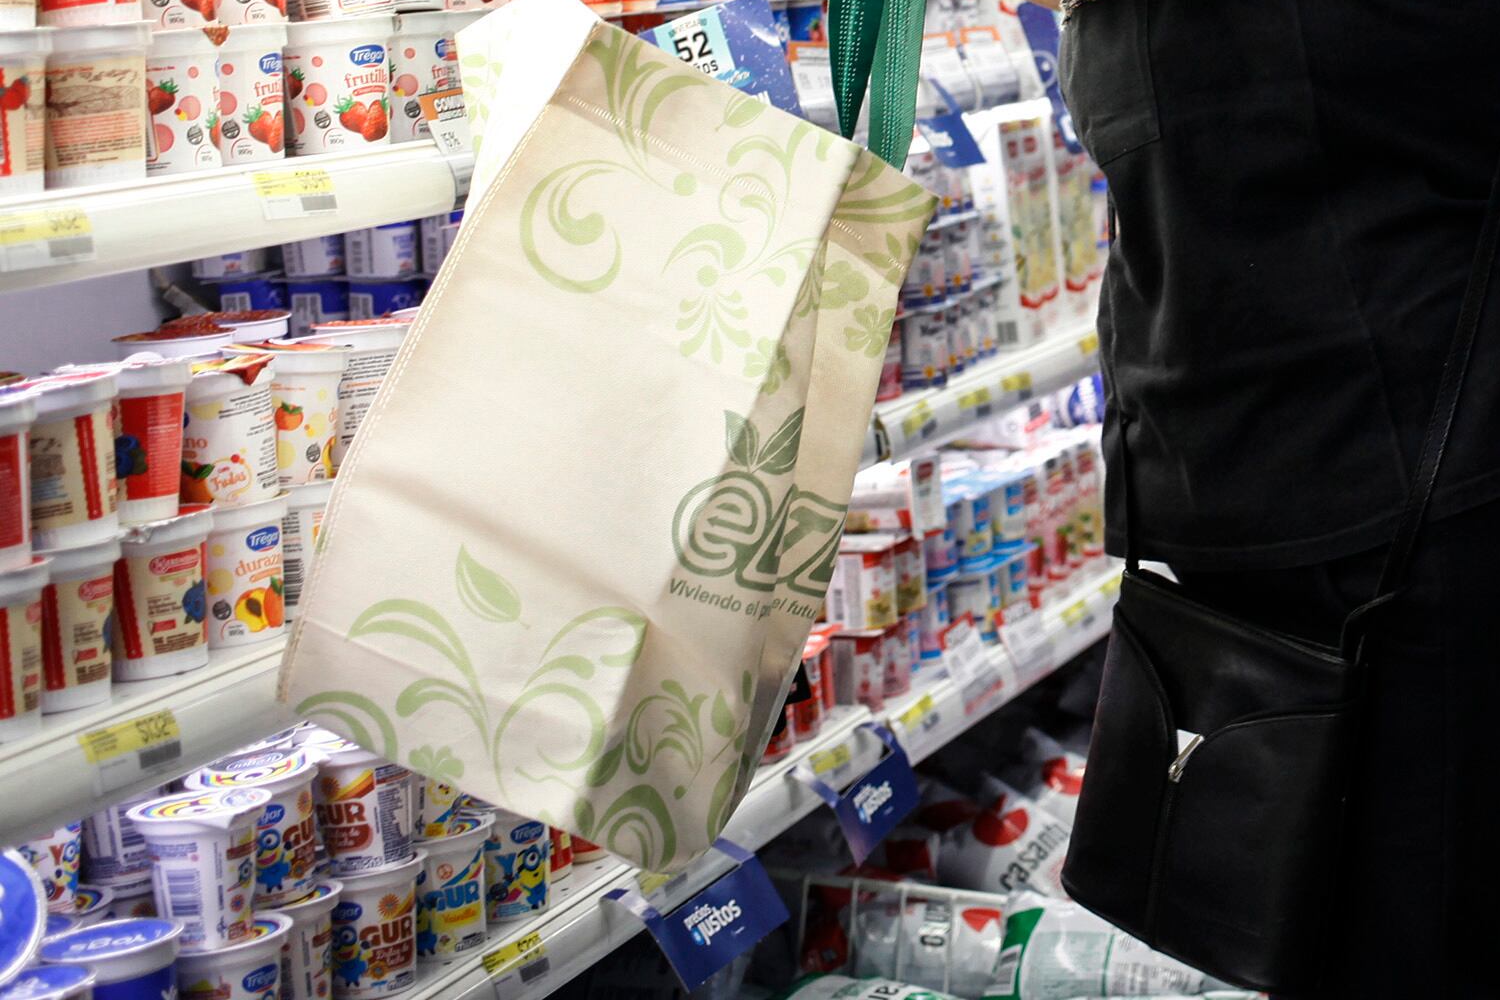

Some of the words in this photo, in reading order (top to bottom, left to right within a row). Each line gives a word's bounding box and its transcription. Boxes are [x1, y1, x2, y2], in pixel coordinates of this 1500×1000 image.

[674, 31, 713, 64] 52
[669, 578, 742, 614] Viviendo
[744, 602, 760, 616] el
[359, 917, 413, 945] GUR
[683, 903, 712, 931] precios
[697, 899, 743, 946] justos
